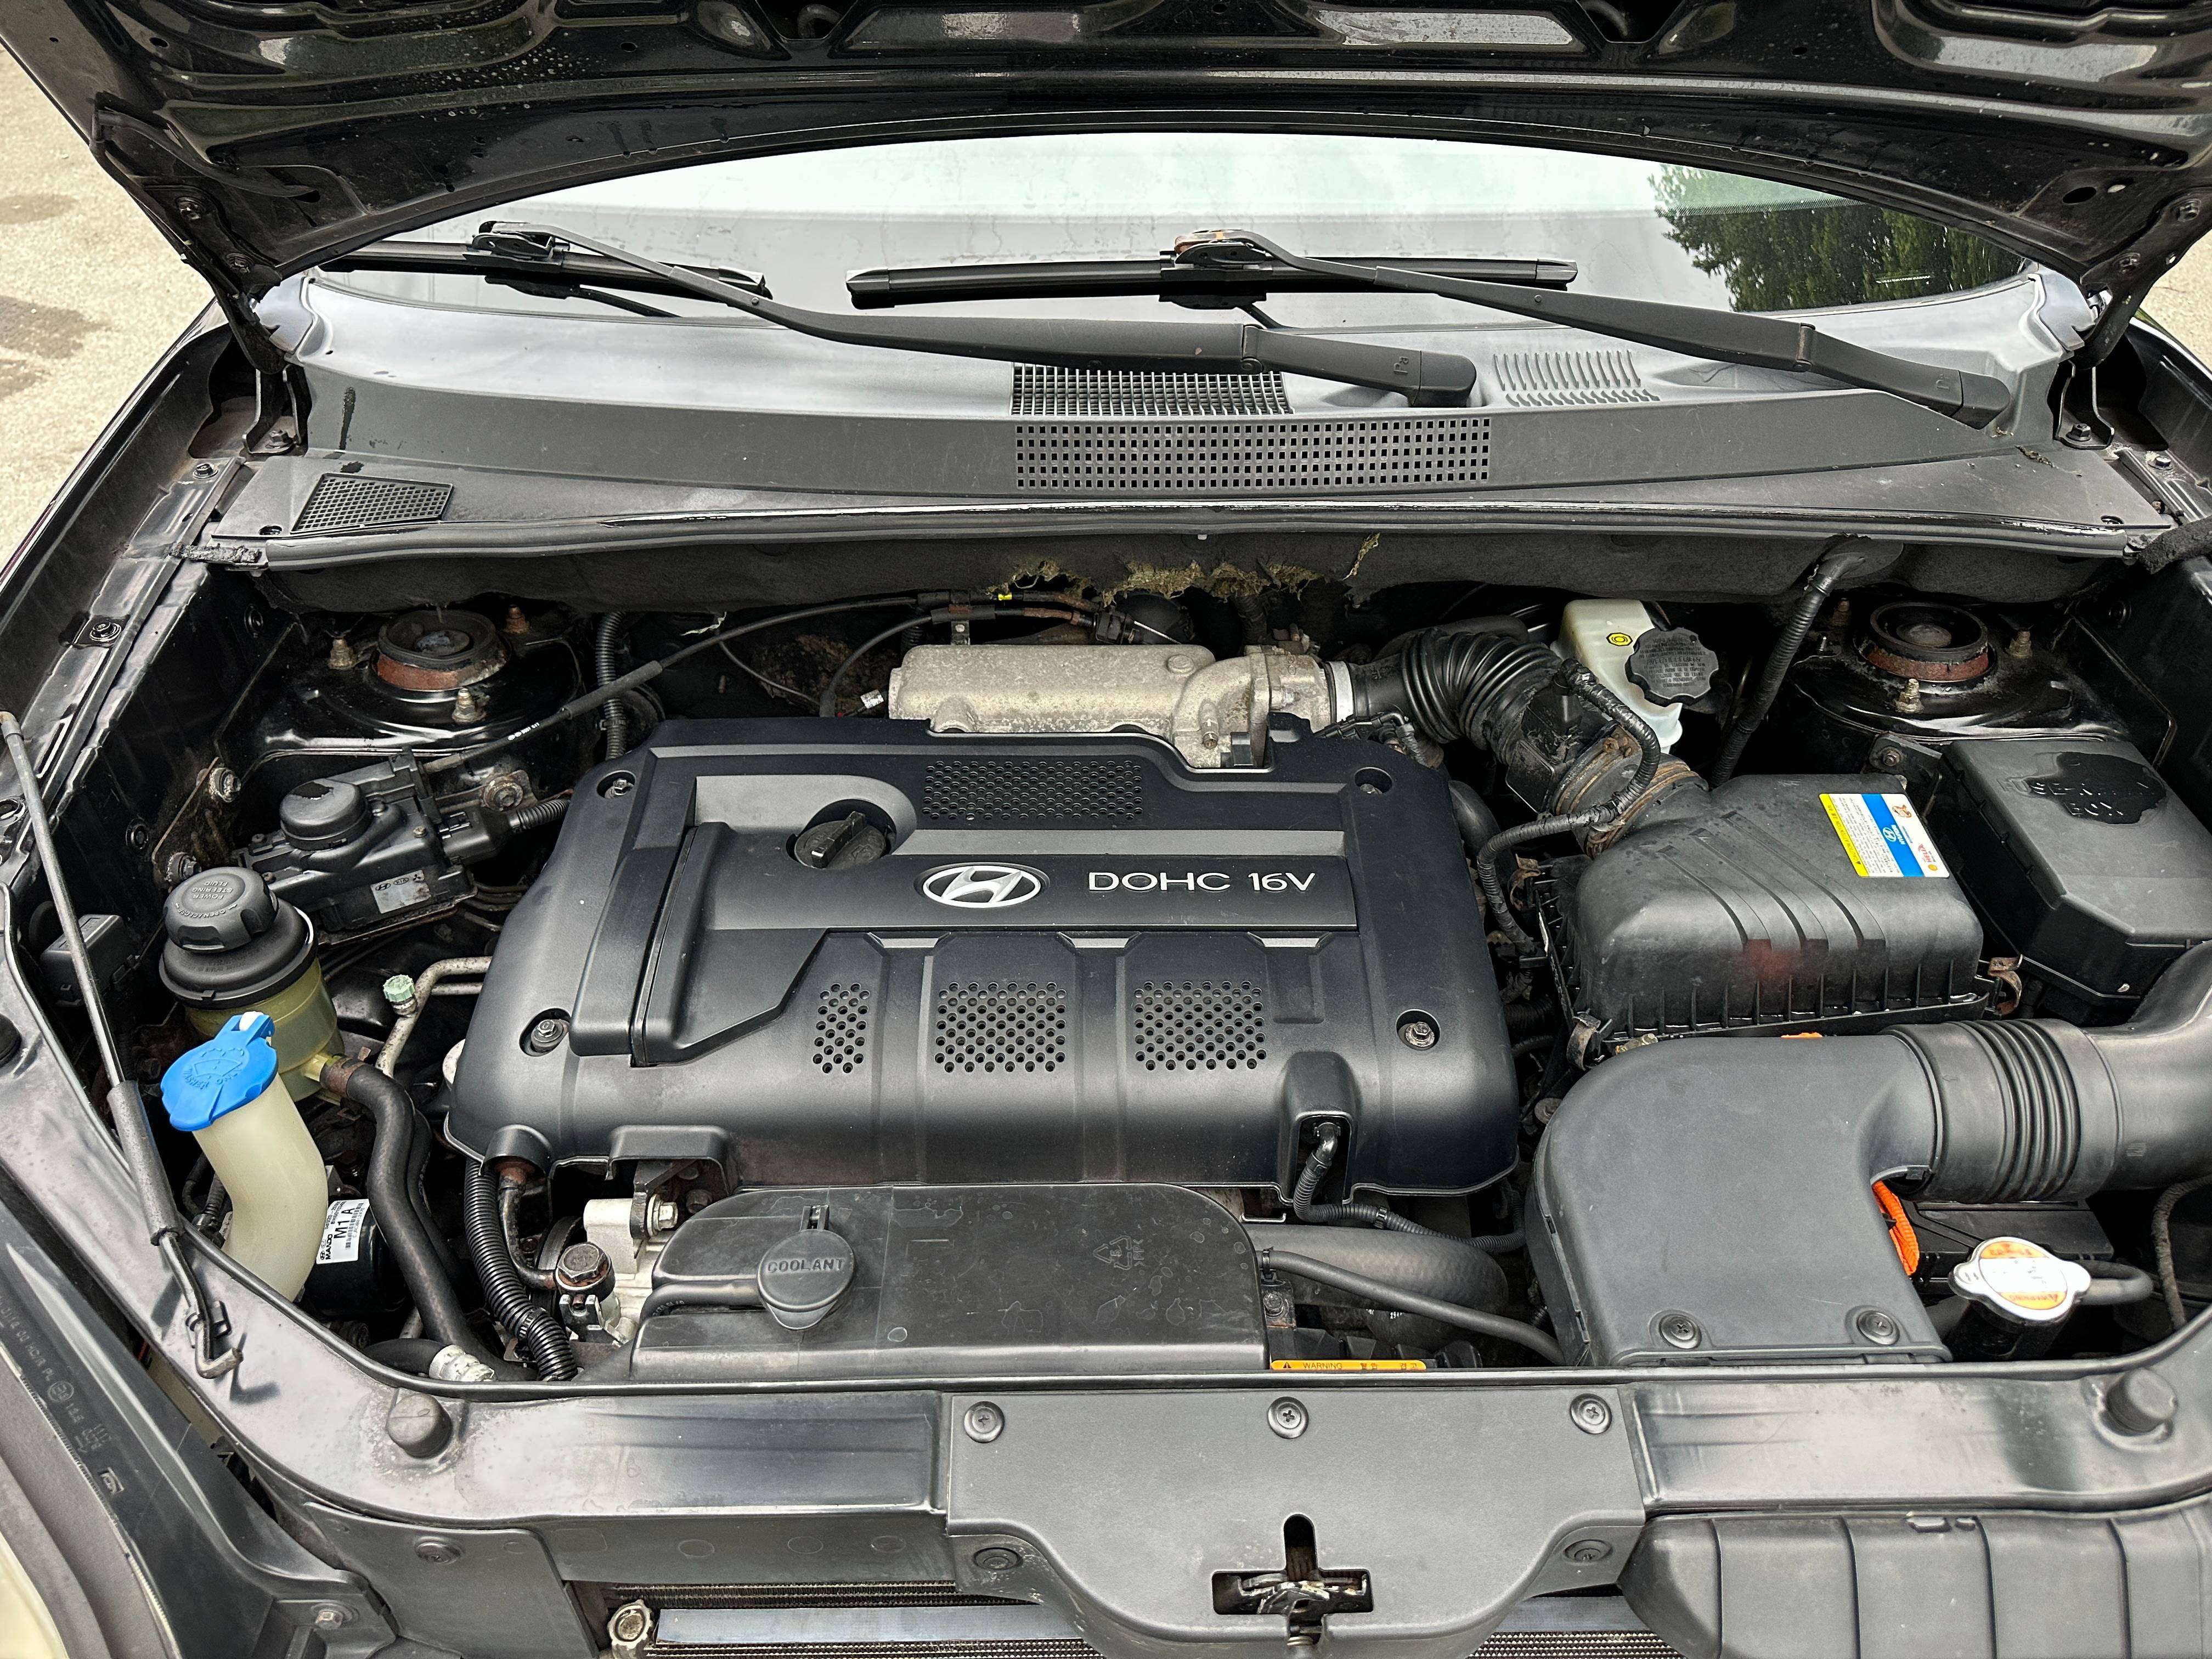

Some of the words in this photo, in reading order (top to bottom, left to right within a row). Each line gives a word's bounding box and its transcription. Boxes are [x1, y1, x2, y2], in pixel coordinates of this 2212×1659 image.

[1890, 825, 1906, 844] HYUNDAI
[1087, 871, 1231, 892] DOHC
[1247, 872, 1316, 892] 16V
[767, 1258, 845, 1273] COOLANT
